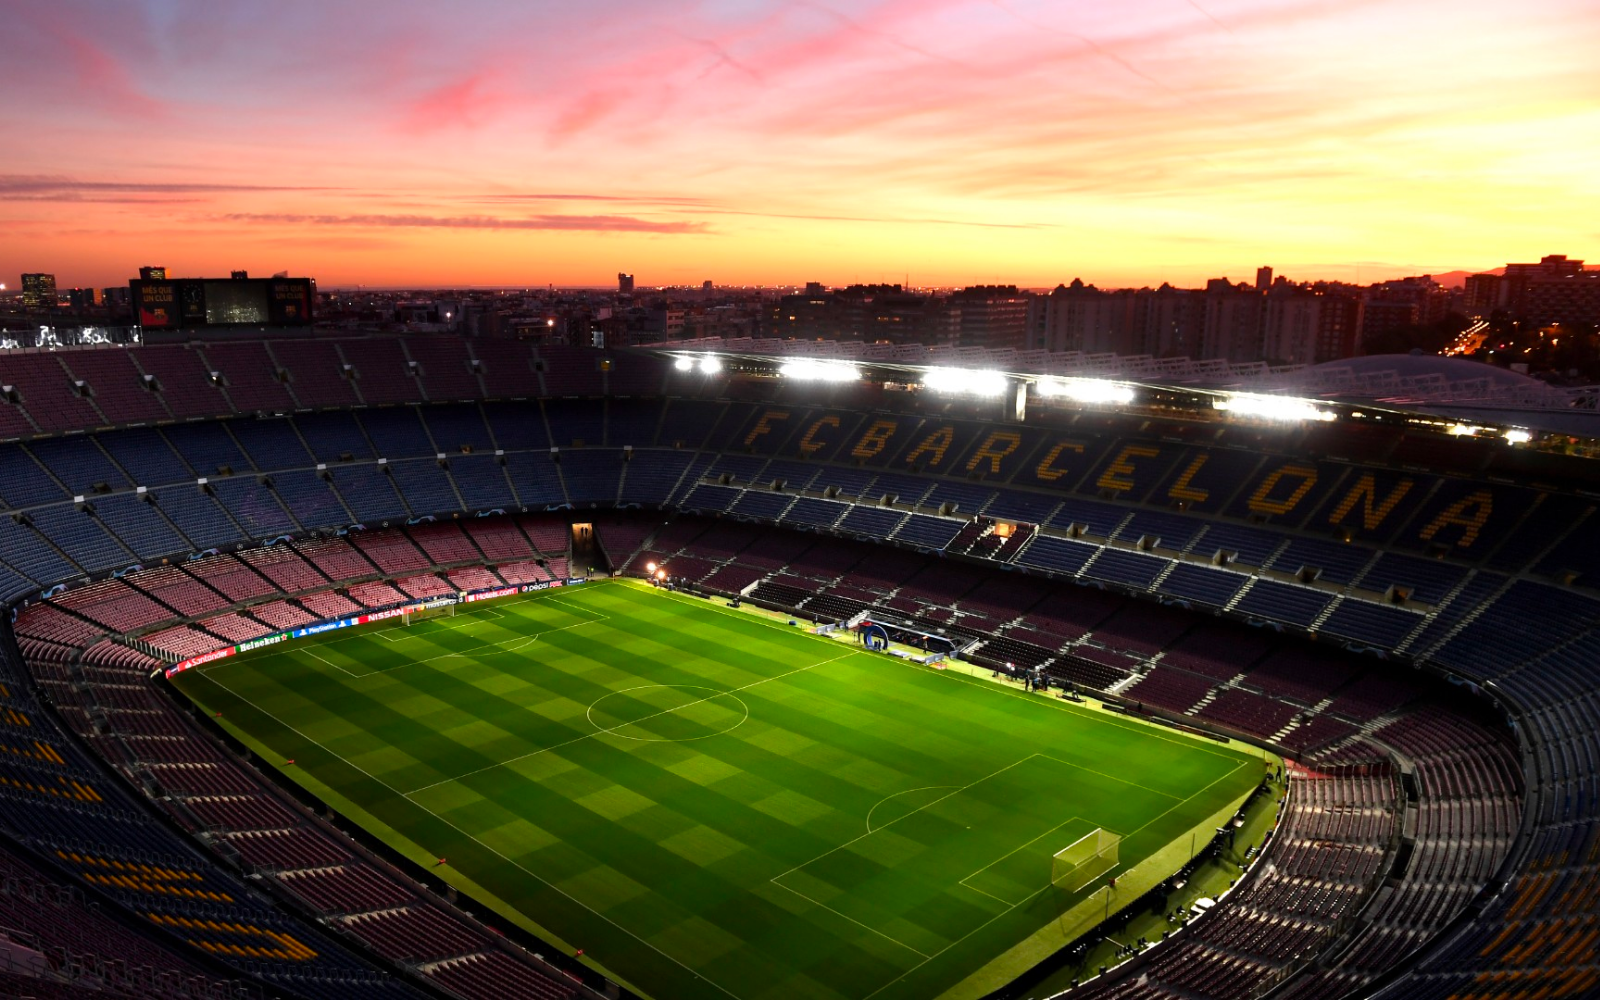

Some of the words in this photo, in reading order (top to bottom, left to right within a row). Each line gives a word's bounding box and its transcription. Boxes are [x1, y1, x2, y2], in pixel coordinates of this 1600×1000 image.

[142, 285, 157, 294] MÉS
[529, 582, 548, 592] pepsi
[476, 587, 514, 600] Hotels.com
[426, 597, 464, 609] mastercad
[368, 608, 403, 621] NISSAN
[309, 622, 337, 633] PlayStation
[240, 635, 281, 652] Heineken
[192, 650, 227, 665] Santander
